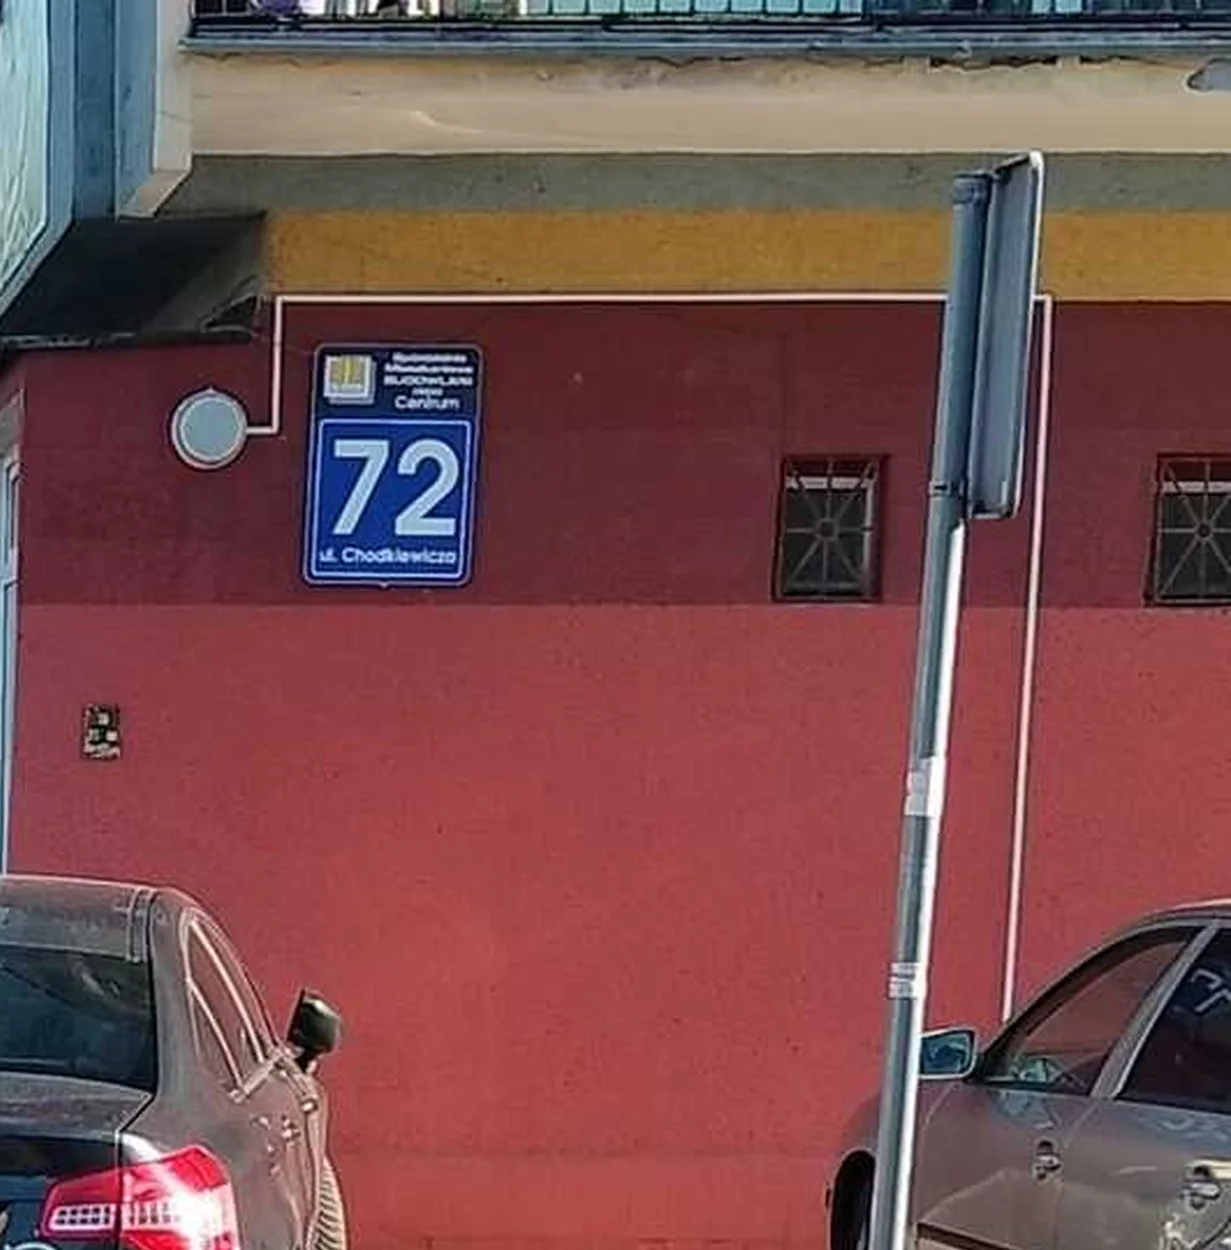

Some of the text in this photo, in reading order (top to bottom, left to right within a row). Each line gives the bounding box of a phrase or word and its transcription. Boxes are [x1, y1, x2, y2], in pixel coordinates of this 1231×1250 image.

[394, 395, 460, 409] Centrum
[333, 438, 460, 536] 72
[319, 547, 456, 563] ul. Chodkiewicza
